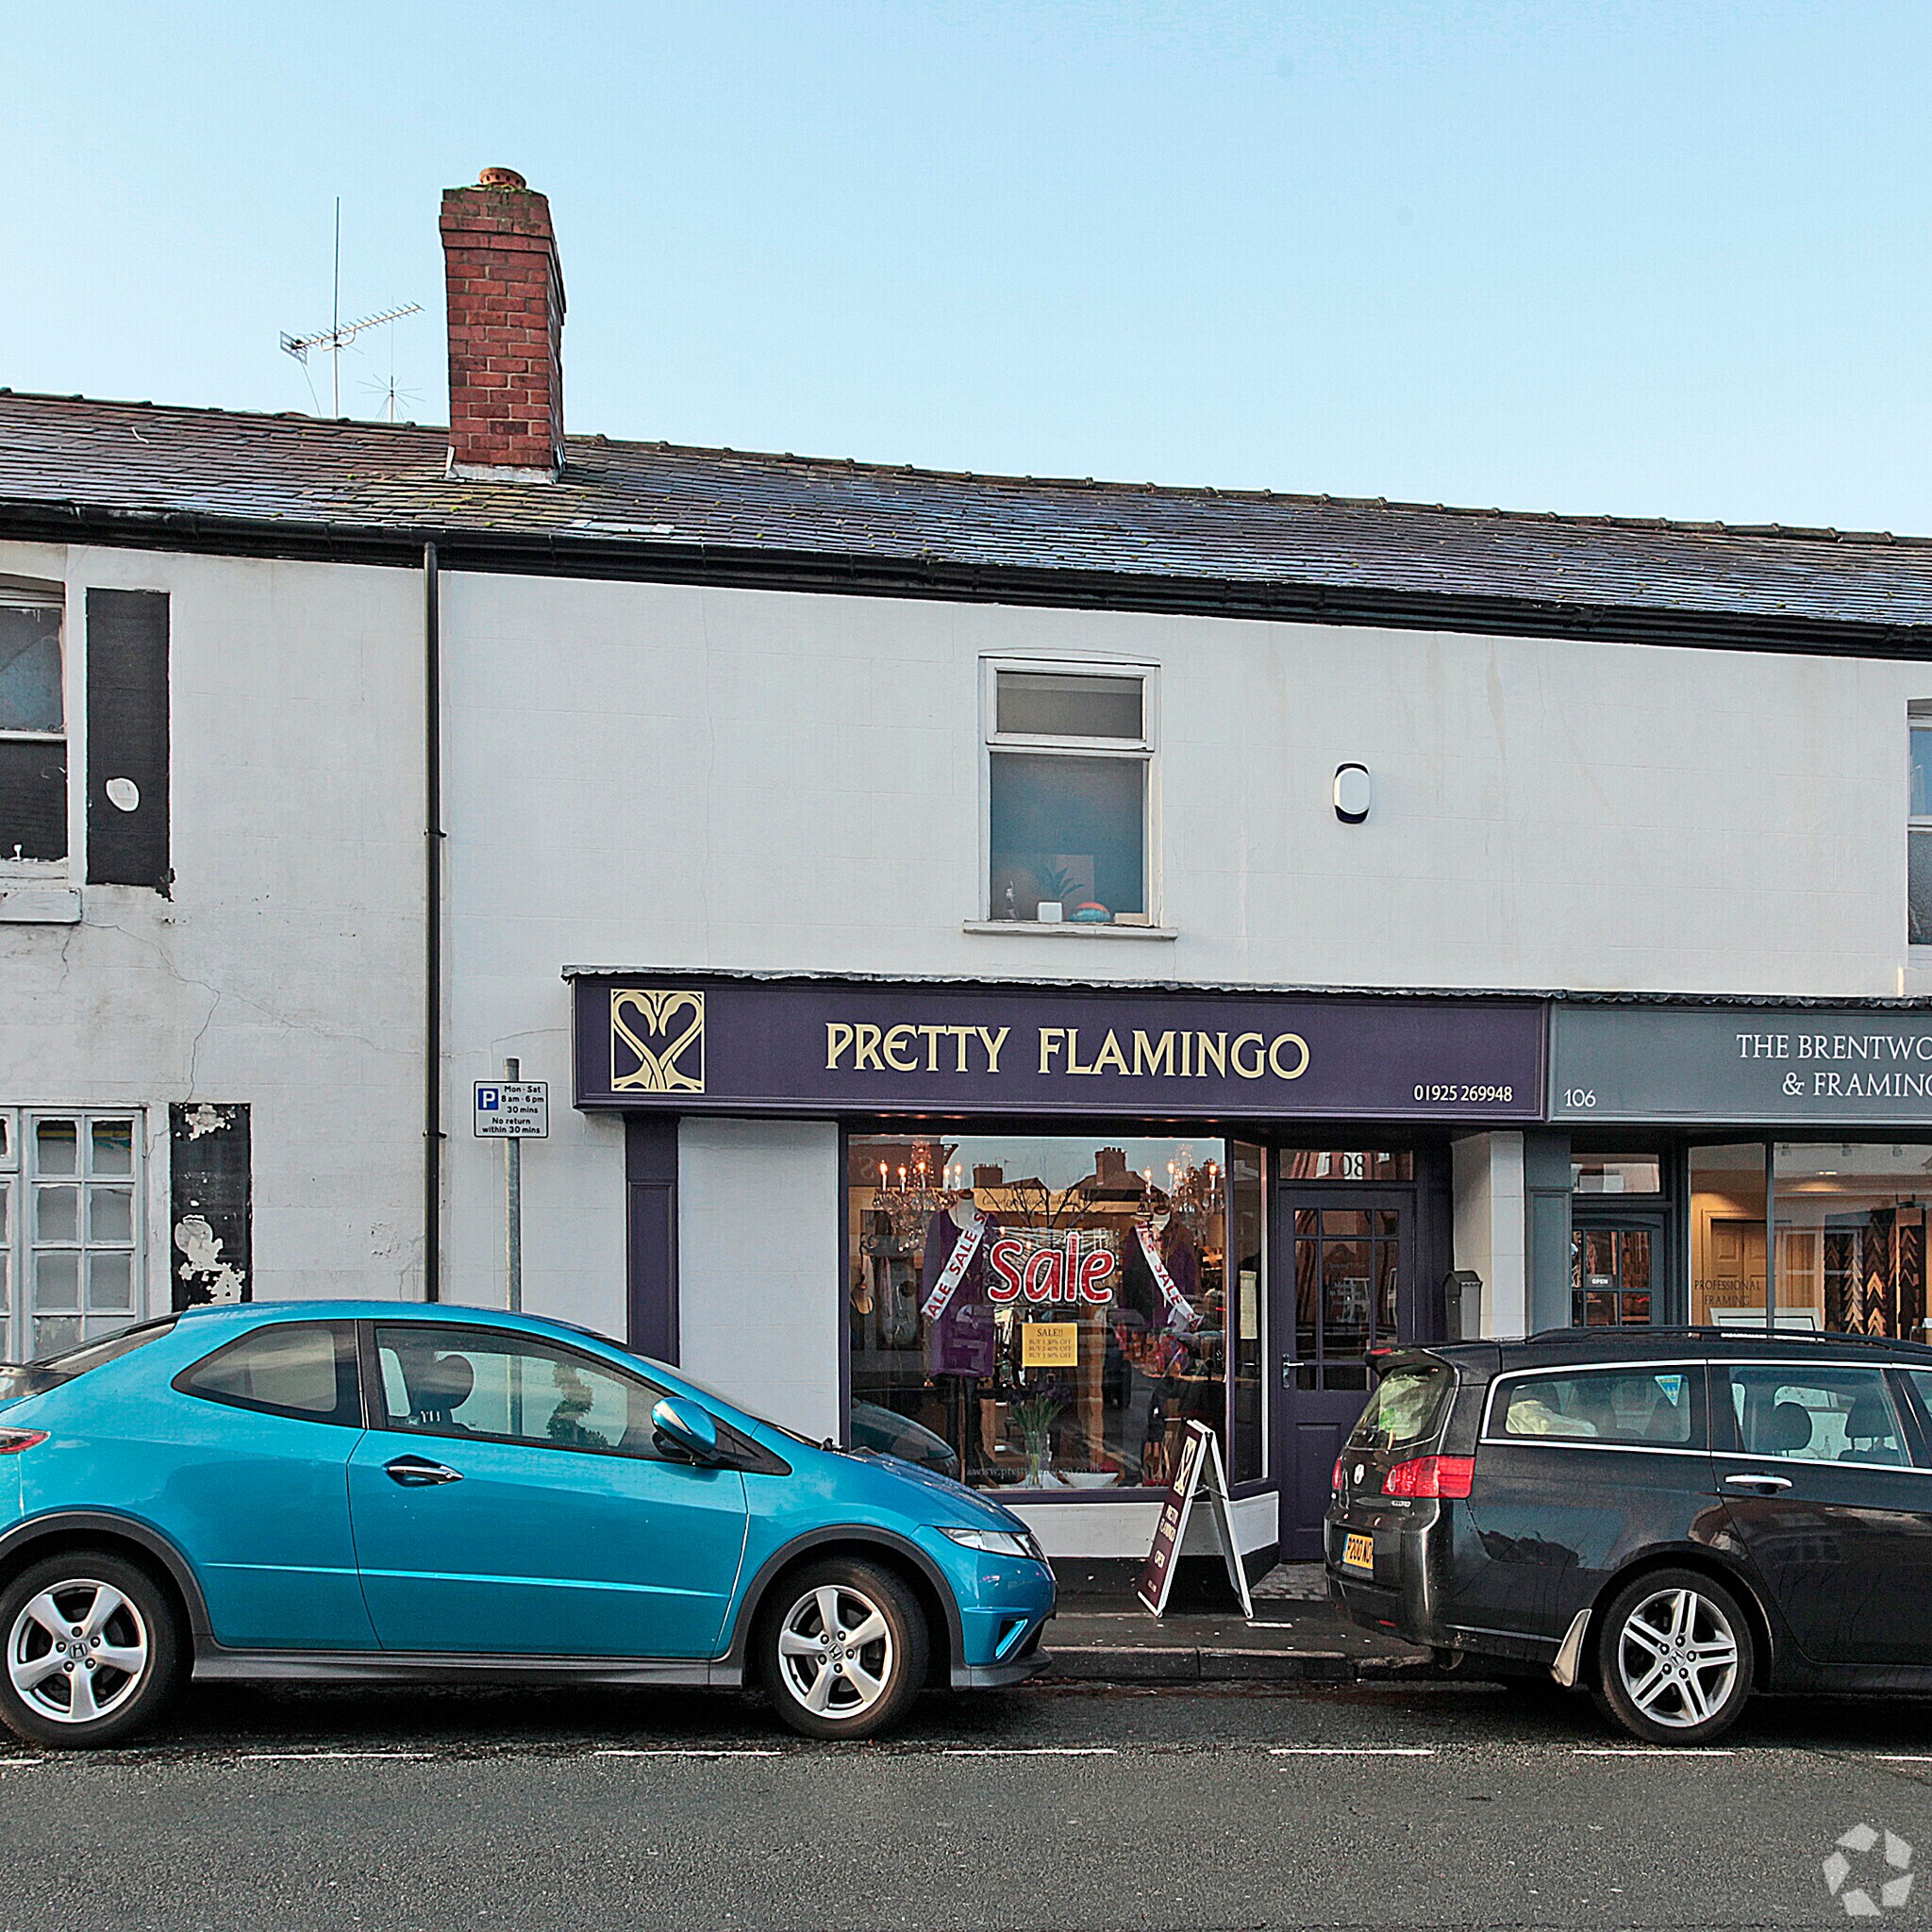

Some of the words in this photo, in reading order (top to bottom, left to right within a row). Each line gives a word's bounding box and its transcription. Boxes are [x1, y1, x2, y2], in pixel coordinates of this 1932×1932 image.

[825, 1023, 1010, 1073] PRETTY
[1038, 1027, 1310, 1079] FLAMINGO
[1736, 1034, 1790, 1058] THE
[1797, 1035, 1932, 1060] BRENTWO
[504, 1085, 521, 1093] Mon
[526, 1085, 541, 1093] Sat
[1414, 1084, 1457, 1101] 01925
[1460, 1085, 1513, 1102] 269948
[1782, 1072, 1805, 1096] &
[482, 1091, 496, 1108] P
[1563, 1089, 1596, 1108] 106
[507, 1106, 519, 1114] 30
[520, 1106, 539, 1114] mins
[508, 1125, 521, 1134] 30
[522, 1125, 541, 1134] mins
[1324, 1153, 1366, 1177] 108
[948, 1229, 978, 1276] SALE
[988, 1230, 1116, 1304] Sale
[1154, 1262, 1184, 1307] SALE
[1591, 1277, 1609, 1286] OPEN
[1693, 1279, 1761, 1291] PROFESSIONAL
[1704, 1294, 1751, 1307] FRAMING
[1037, 1327, 1064, 1338] SALE!!
